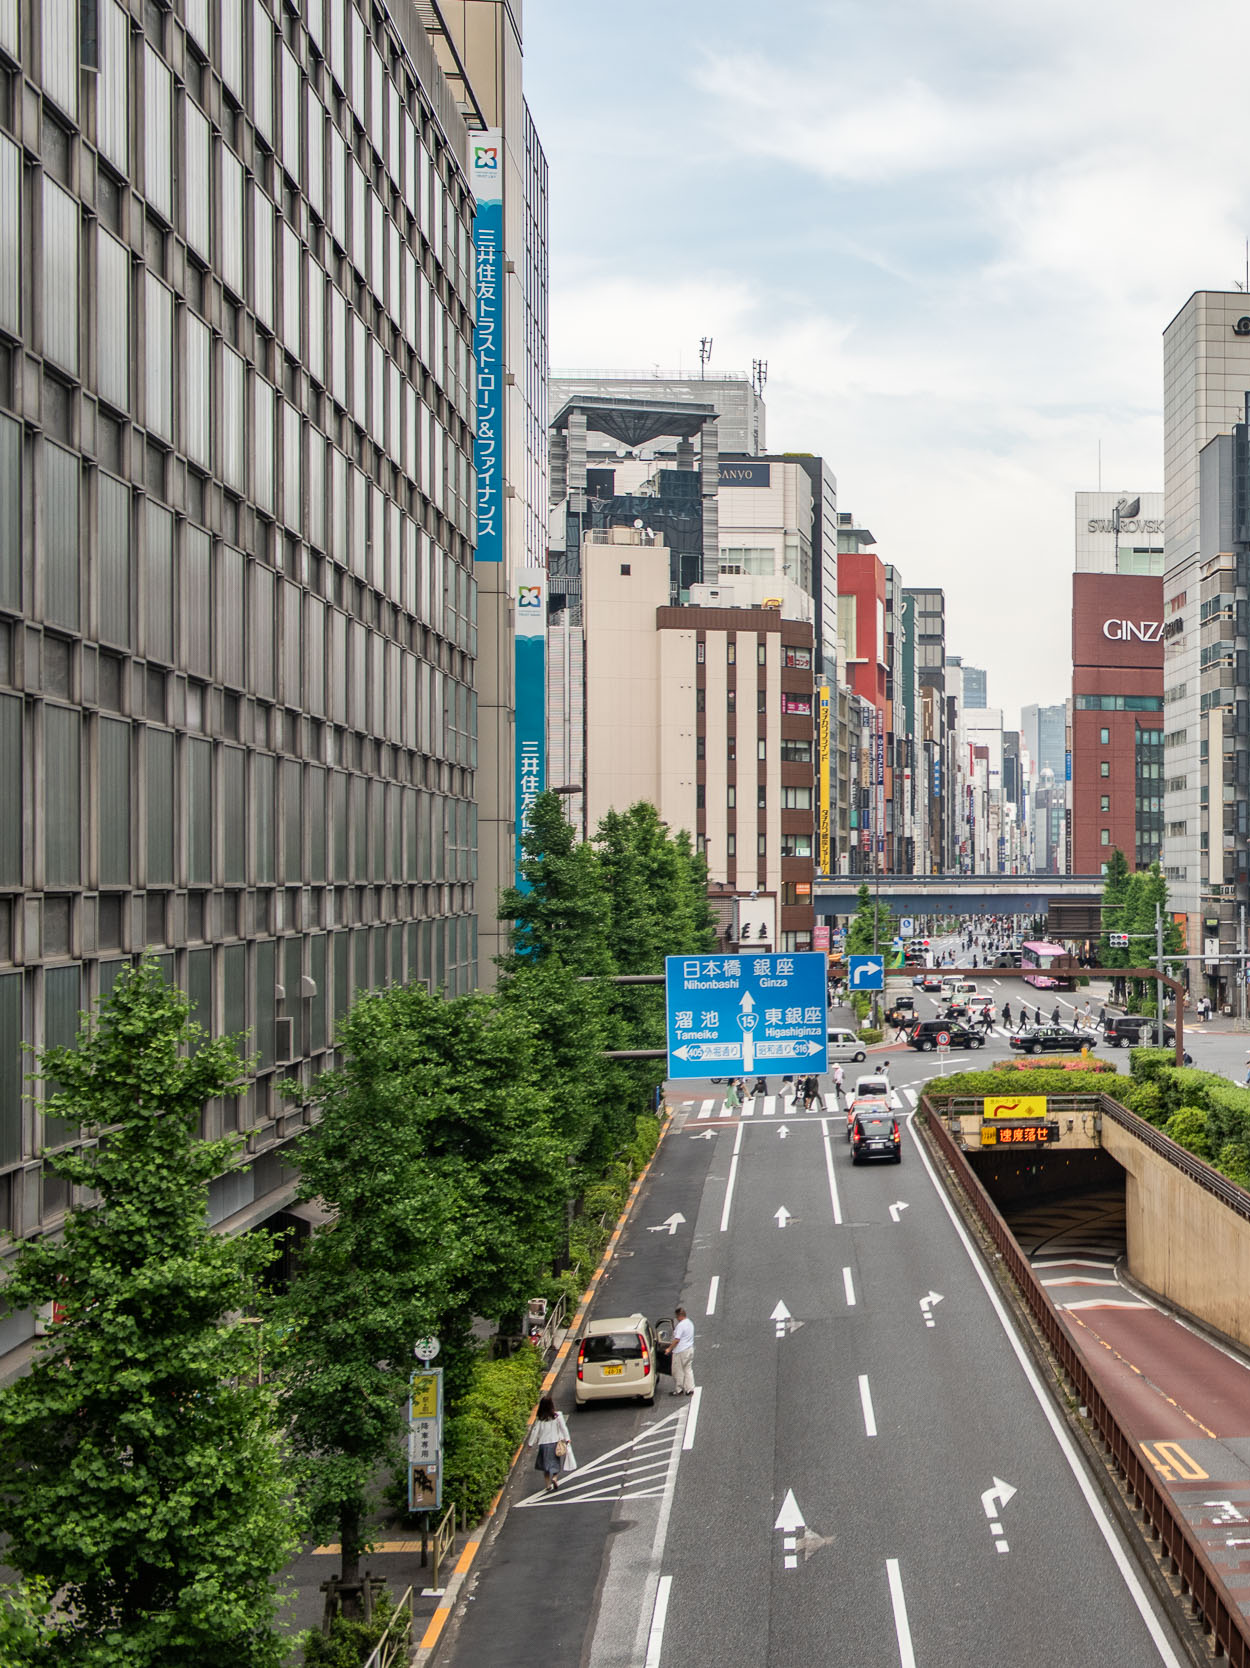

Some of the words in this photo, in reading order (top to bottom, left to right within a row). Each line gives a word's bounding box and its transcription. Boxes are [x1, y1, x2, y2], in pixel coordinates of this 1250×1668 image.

[683, 959, 741, 978] 日本橋
[753, 958, 794, 976] 銀座
[684, 979, 739, 990] Nihonbashi
[759, 977, 788, 988] Ginza
[674, 1010, 719, 1029] 溜池
[740, 1016, 754, 1028] 15
[764, 1007, 822, 1025] 東銀座
[675, 1030, 719, 1040] Tameike
[765, 1027, 822, 1038] Higashiginza
[688, 1048, 703, 1058] 405
[1000, 1127, 1048, 1142] 速度落せ
